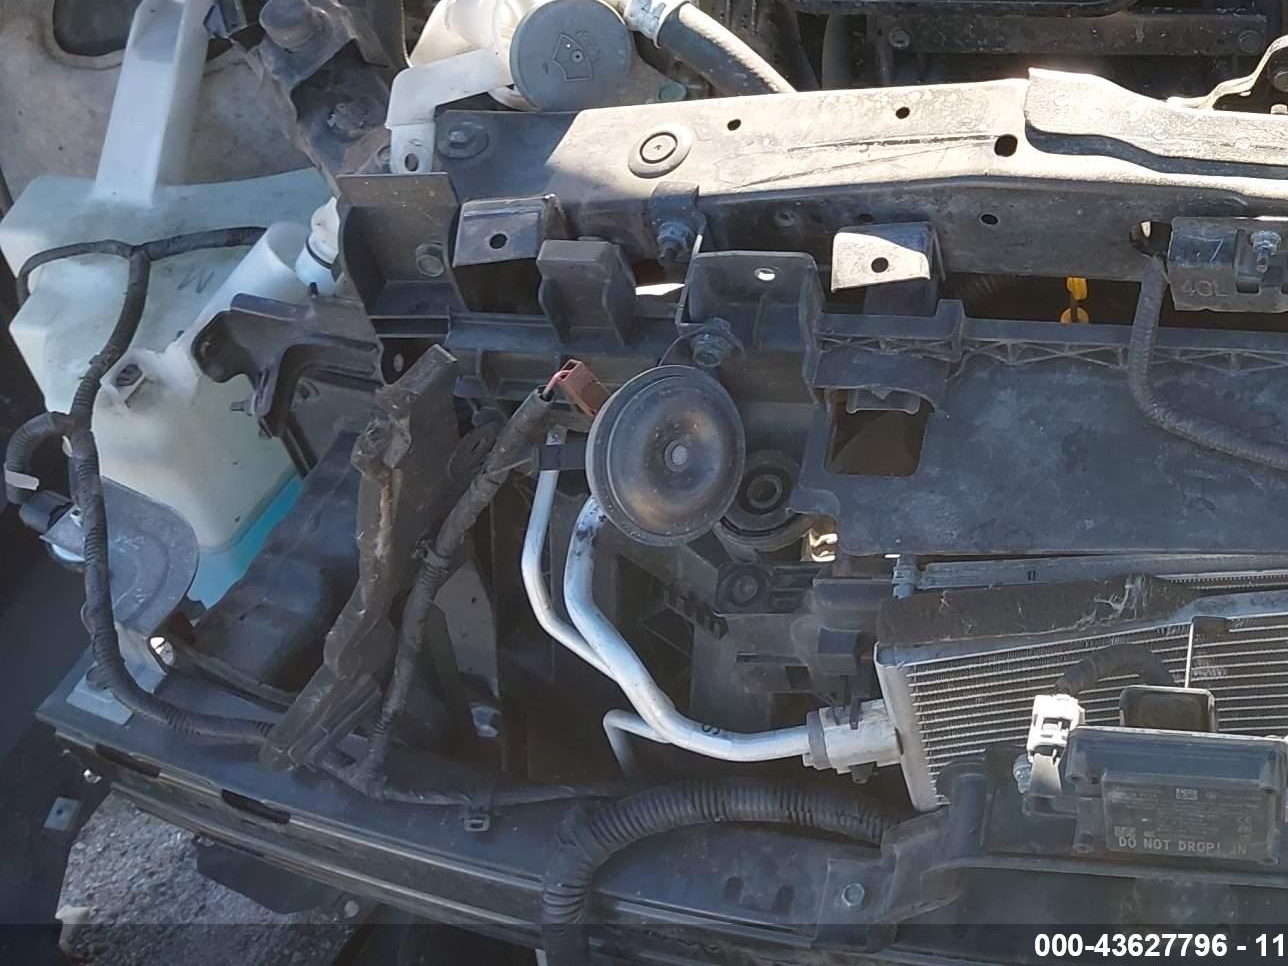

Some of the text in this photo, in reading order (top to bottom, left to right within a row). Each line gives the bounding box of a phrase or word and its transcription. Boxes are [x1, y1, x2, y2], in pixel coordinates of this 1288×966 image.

[1118, 836, 1221, 854] DO NOT DROP!
